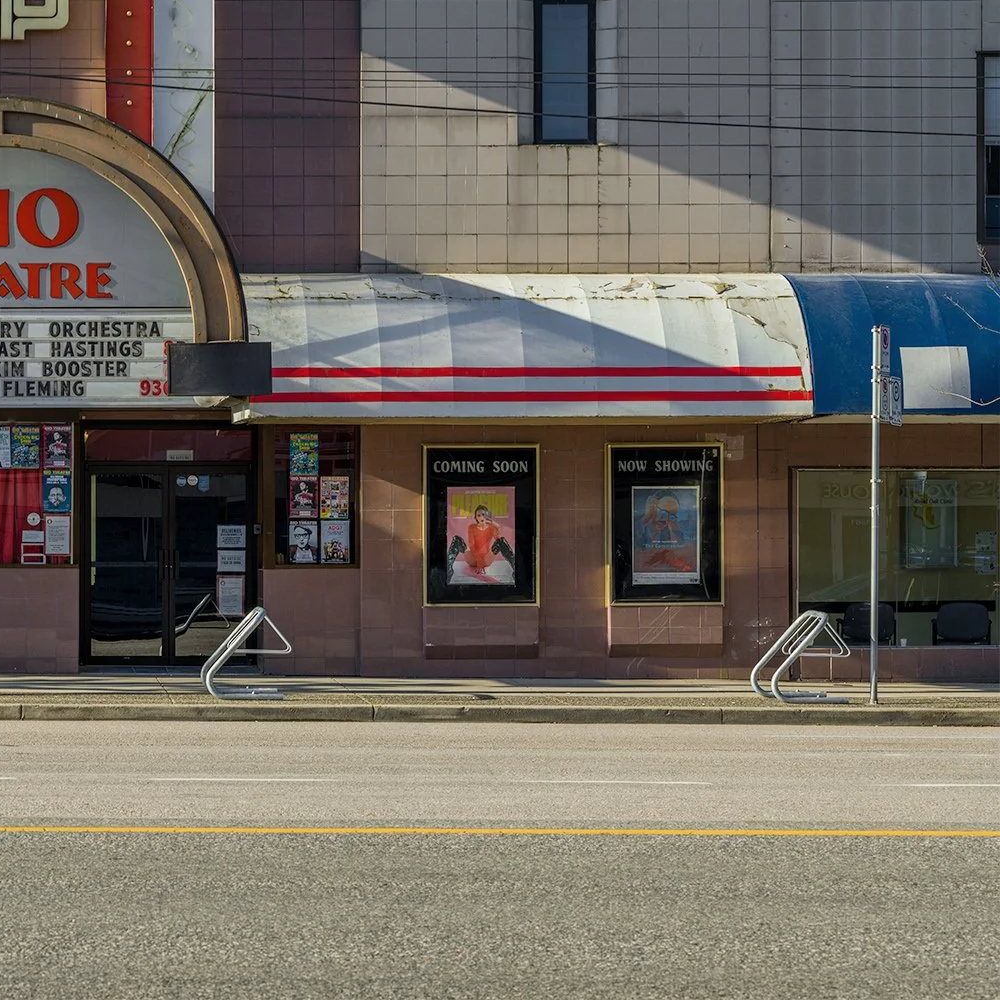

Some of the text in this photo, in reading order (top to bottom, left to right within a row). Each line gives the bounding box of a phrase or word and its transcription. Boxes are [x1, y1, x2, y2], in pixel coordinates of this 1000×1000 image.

[49, 321, 161, 338] ORCHESTRA
[50, 341, 143, 358] HASTINGS
[42, 360, 128, 377] BOOSTER
[3, 380, 85, 397] FLEMING
[433, 460, 529, 473] COMING SOON
[618, 459, 714, 473] NOW SHOWING
